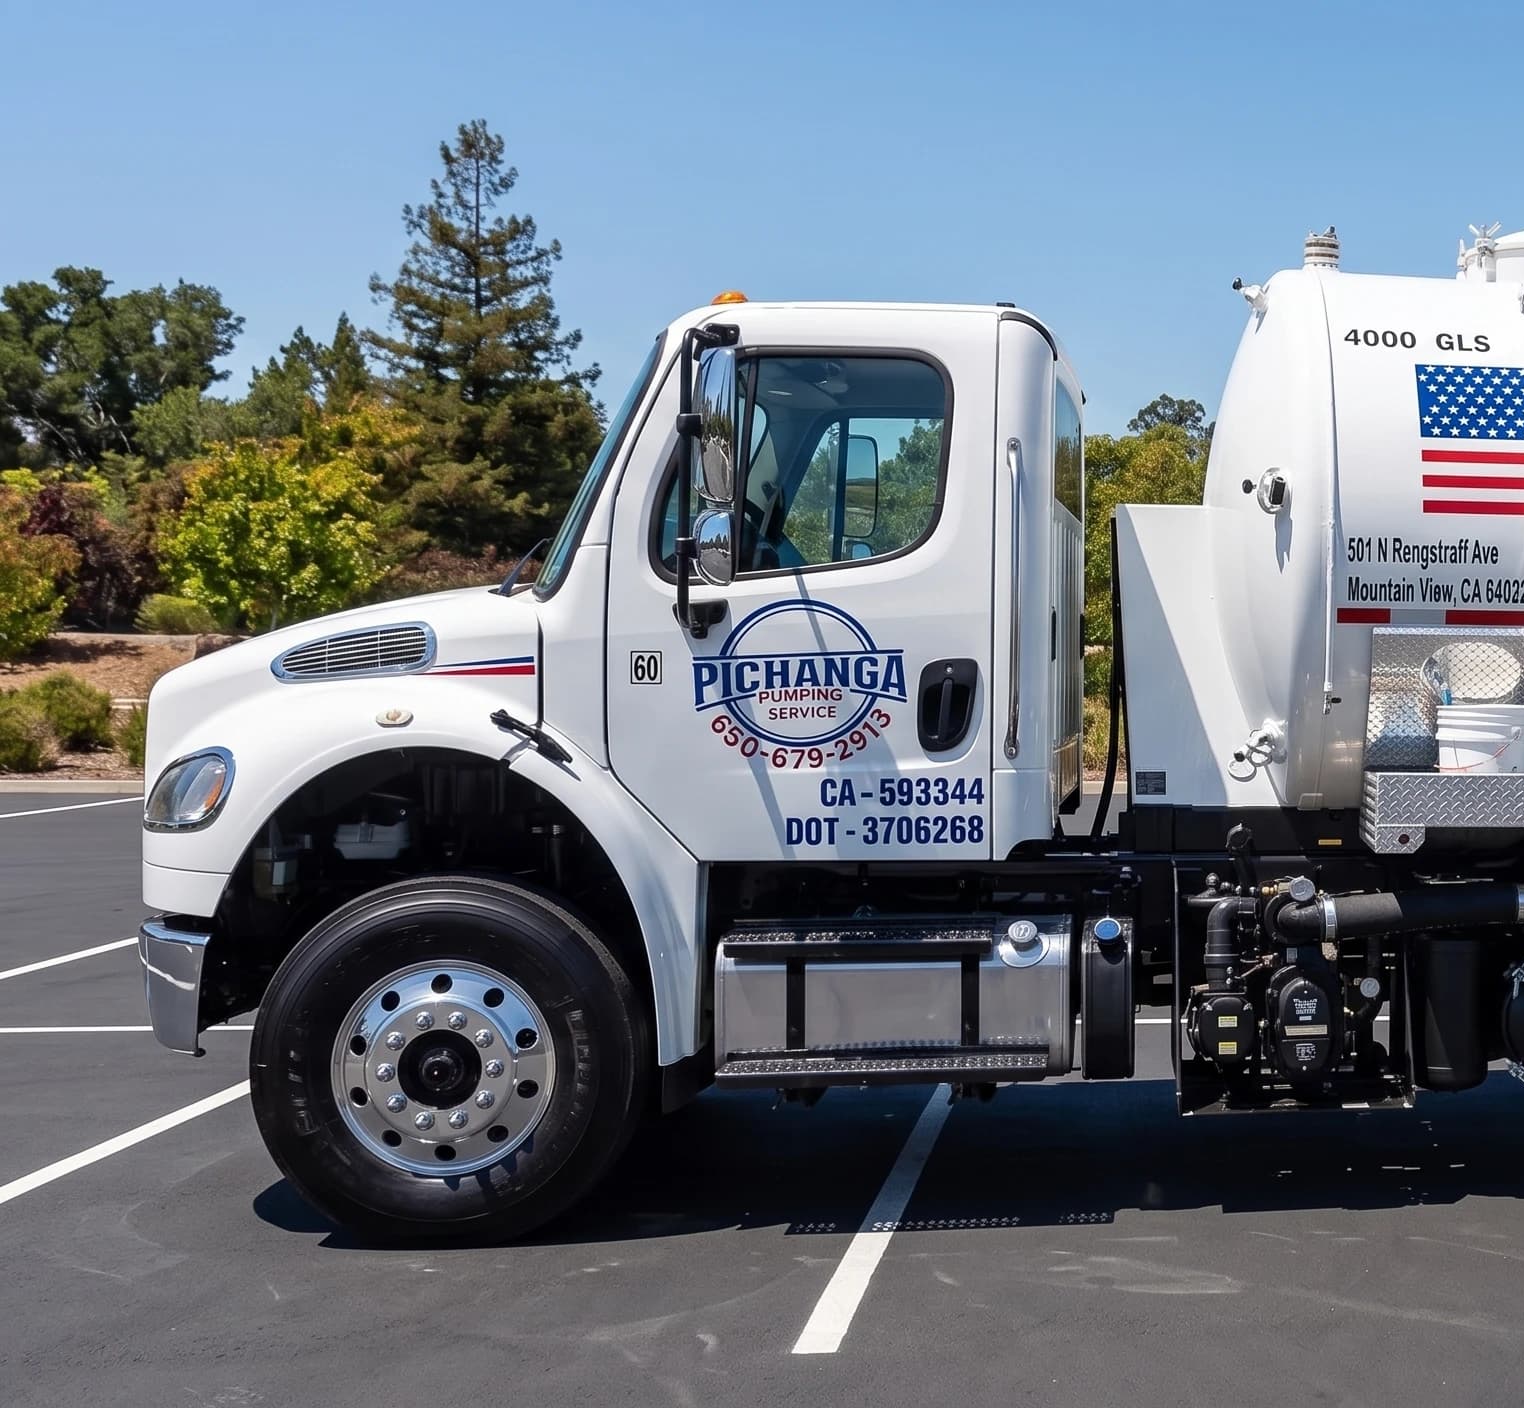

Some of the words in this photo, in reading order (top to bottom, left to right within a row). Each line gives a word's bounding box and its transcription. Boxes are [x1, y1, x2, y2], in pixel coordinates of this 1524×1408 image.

[1344, 329, 1417, 349] 4000
[1435, 333, 1491, 352] GLS
[1348, 537, 1372, 562] 501
[1378, 538, 1388, 563] N
[1392, 538, 1469, 570] Rengstraff
[1472, 540, 1499, 565] Ave
[1348, 577, 1414, 602] Mountain
[1420, 578, 1457, 607] View,
[1461, 579, 1482, 604] CA
[634, 655, 658, 681] 60
[692, 655, 906, 705] PICHANGA
[758, 687, 843, 704] PUMPING
[768, 706, 837, 721] SERVICE
[710, 707, 892, 770] 650-679-2913
[820, 778, 856, 807] CA
[880, 778, 985, 807] 593344
[786, 817, 840, 845] DOT
[862, 815, 984, 845] 3706268
